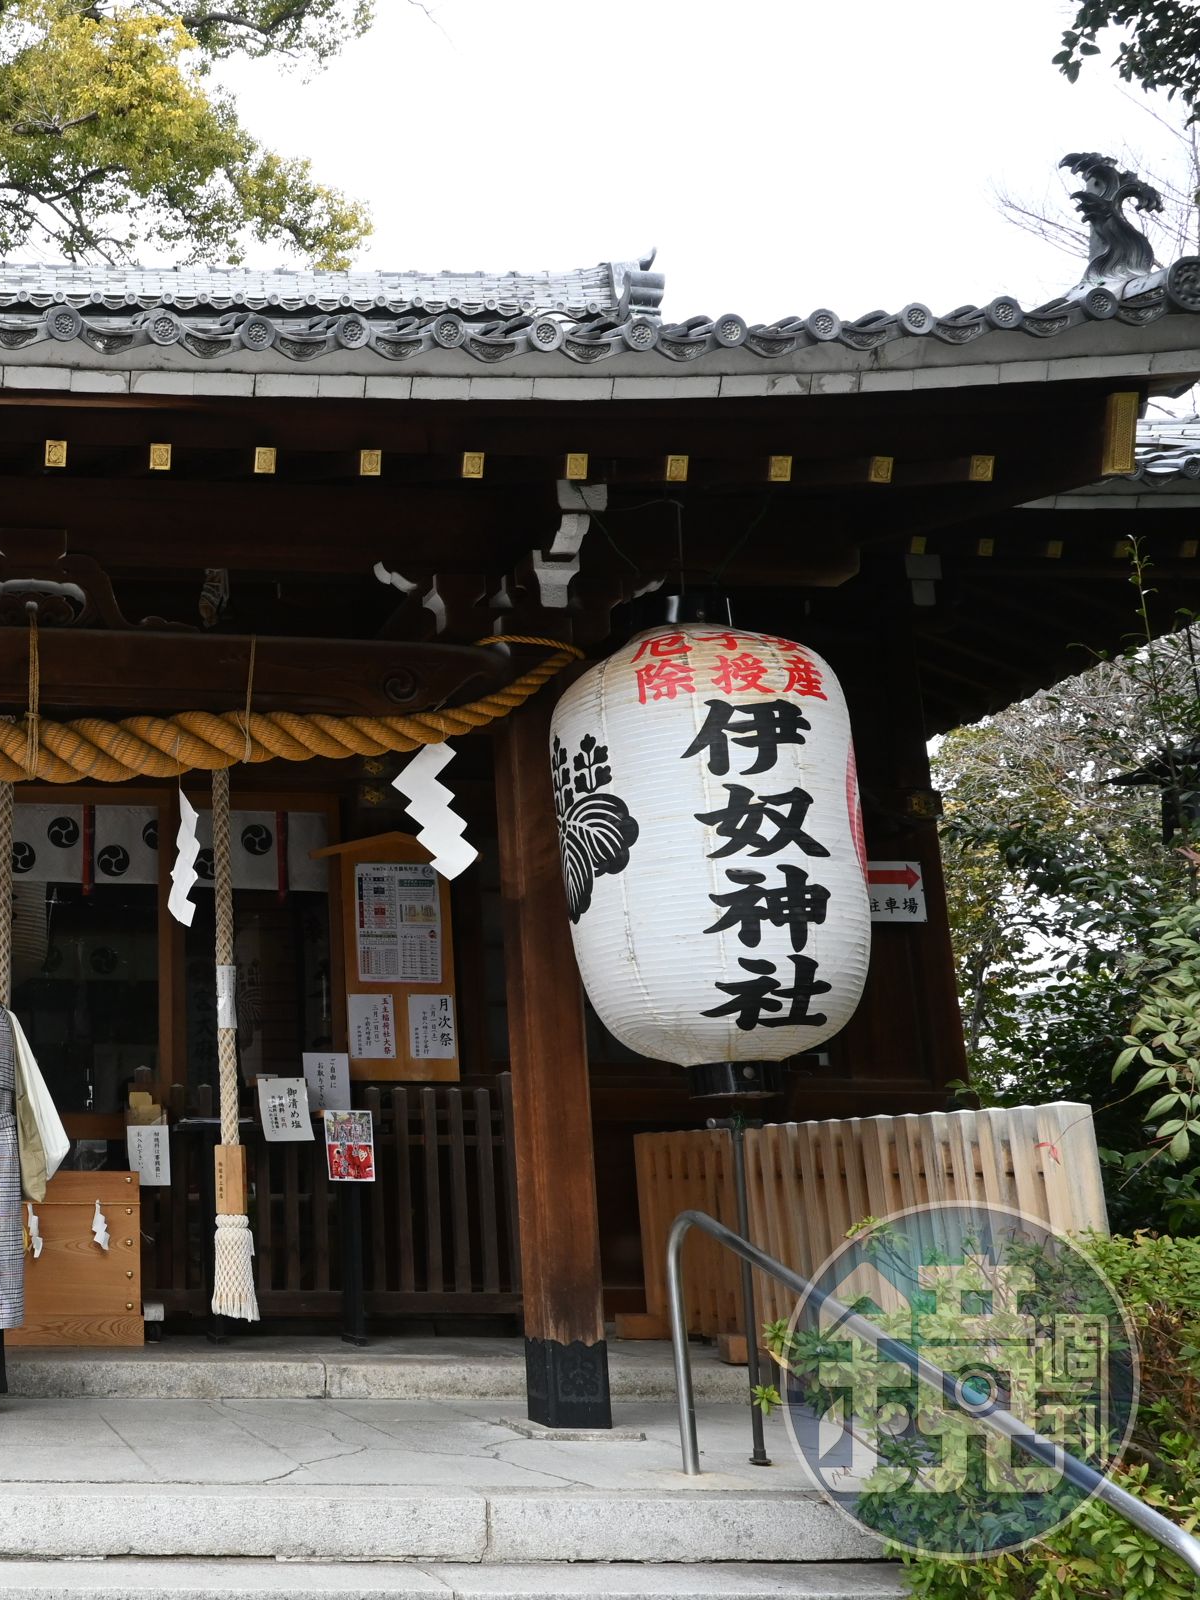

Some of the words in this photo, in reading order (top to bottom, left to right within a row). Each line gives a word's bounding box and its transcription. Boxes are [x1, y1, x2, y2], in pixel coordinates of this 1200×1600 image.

[629, 630, 697, 705] 厄除
[699, 631, 775, 695] 子授
[679, 698, 833, 1032] 伊奴神社
[438, 998, 453, 1047] 月次祭
[329, 1058, 337, 1089] ご自由に
[286, 1087, 303, 1130] 御清め塩
